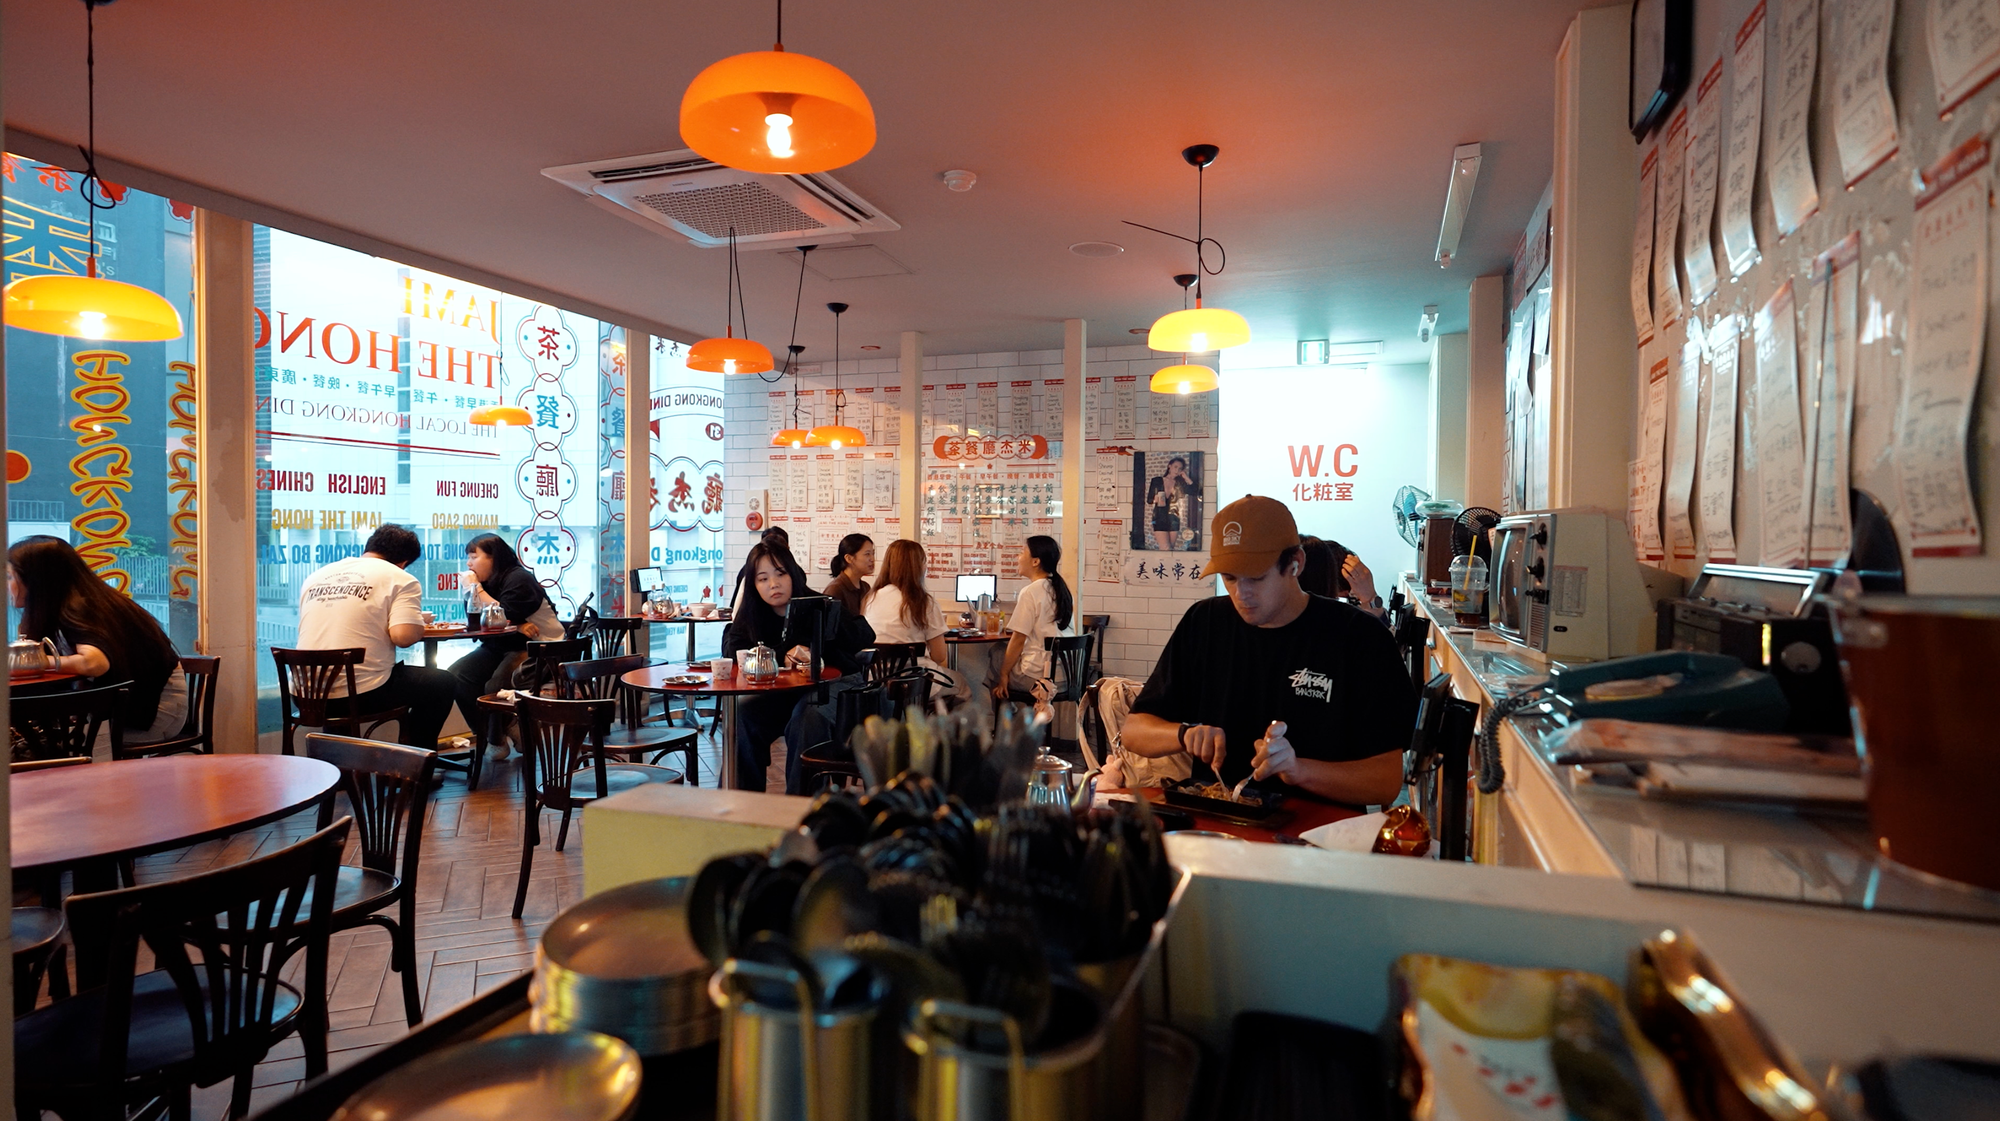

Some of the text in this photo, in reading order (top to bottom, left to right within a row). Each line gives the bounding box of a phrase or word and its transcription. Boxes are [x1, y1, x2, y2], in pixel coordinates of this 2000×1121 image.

[947, 439, 1031, 456] 茶餐廳杰米
[1287, 443, 1358, 477] W.C
[1292, 482, 1354, 502] 化粧室
[1136, 561, 1202, 581] 美味常在
[306, 584, 373, 603] TRANSCENDENCE
